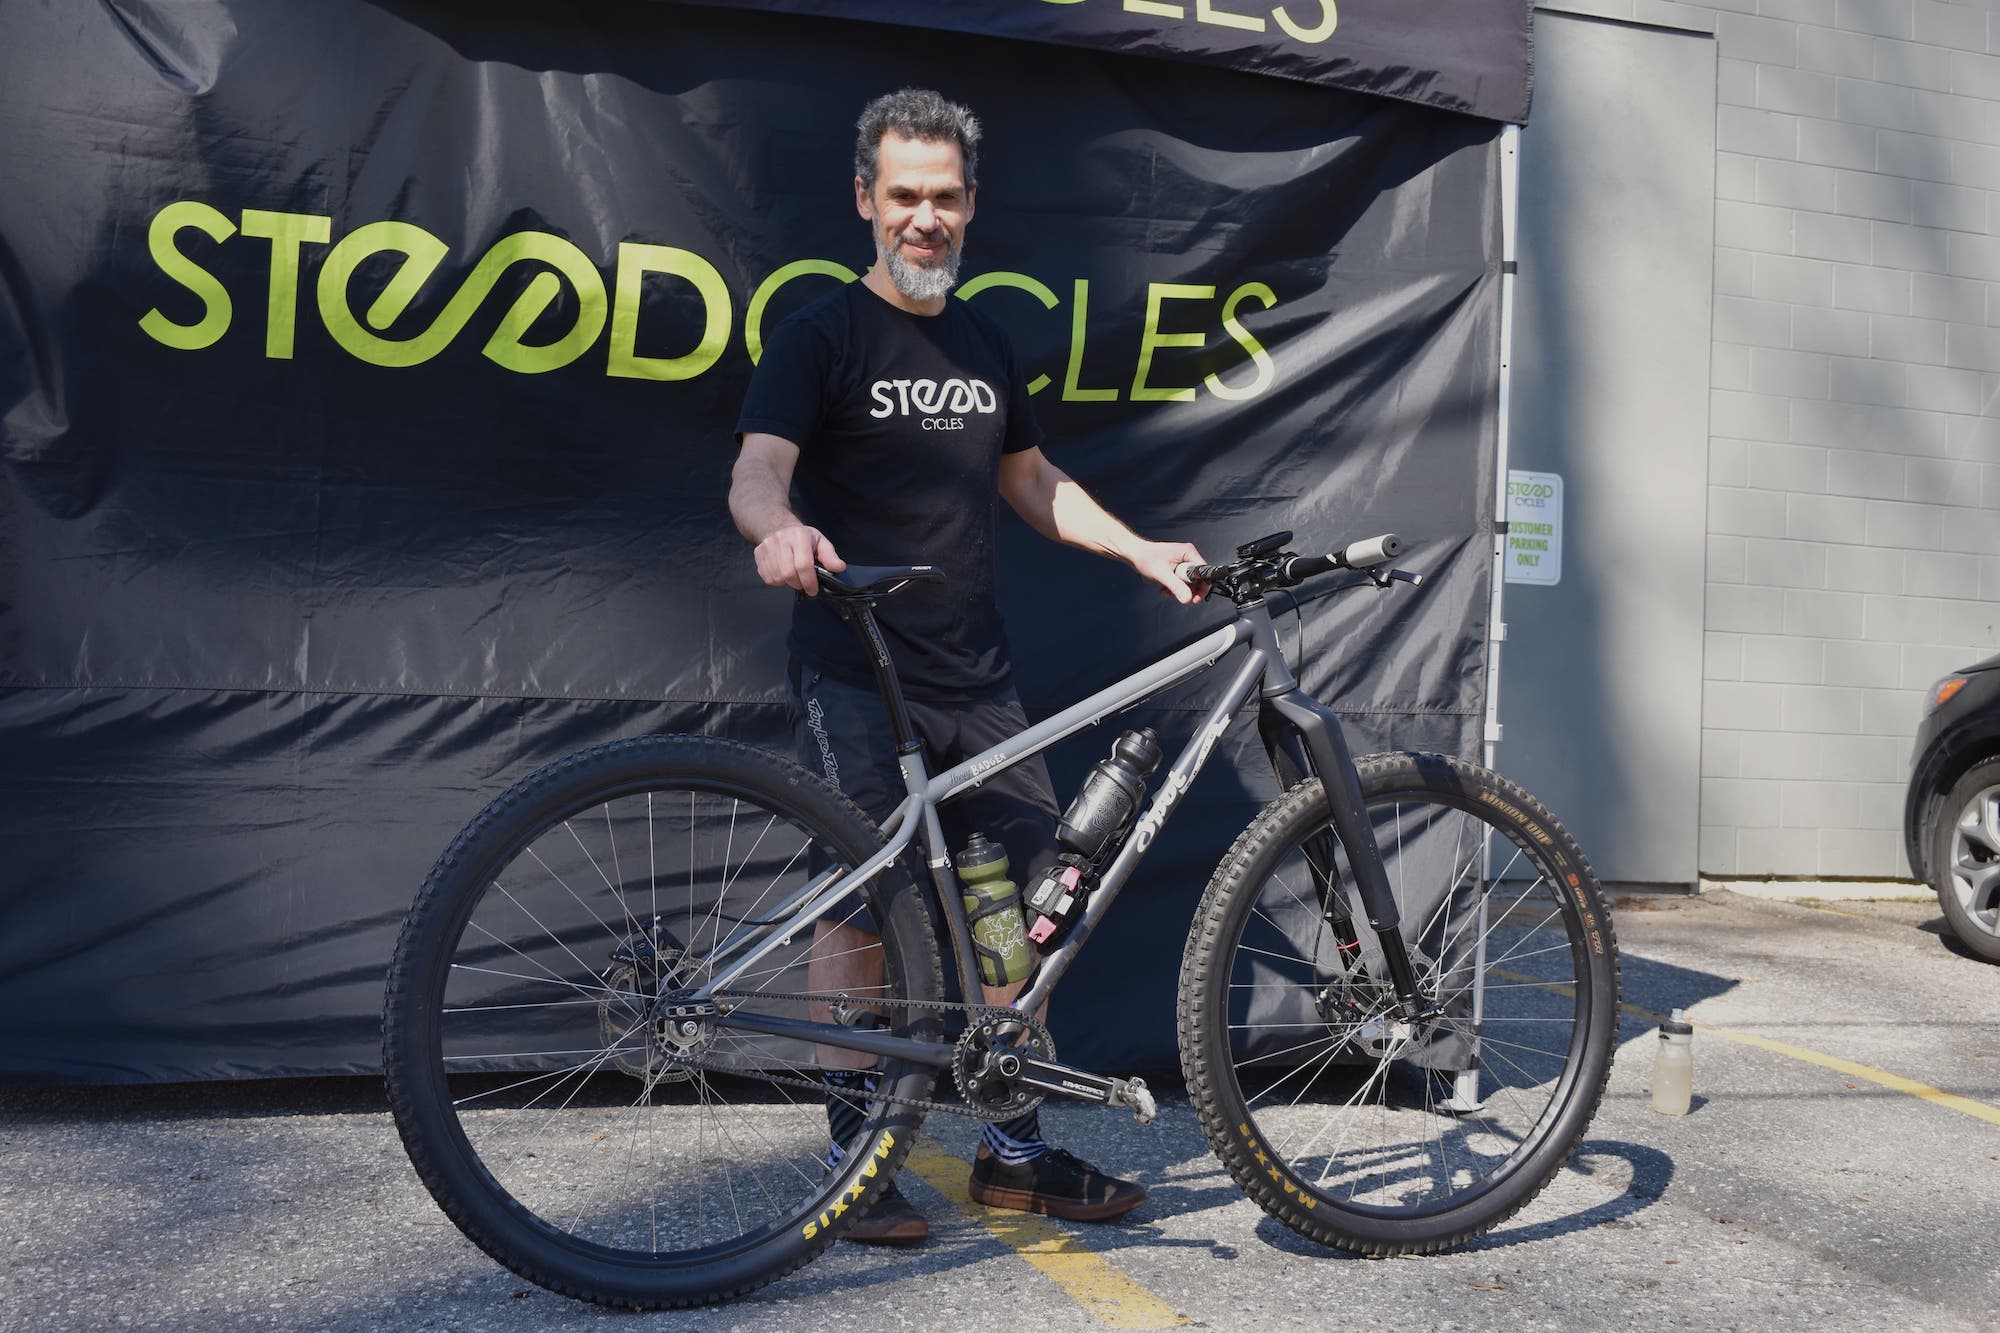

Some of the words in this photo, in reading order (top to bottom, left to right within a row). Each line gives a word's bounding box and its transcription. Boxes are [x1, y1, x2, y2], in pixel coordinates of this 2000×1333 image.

[921, 417, 965, 431] CYCLES
[1509, 537, 1549, 551] PARKING
[1517, 553, 1541, 567] ONLY
[970, 752, 1007, 776] BADGER
[1239, 1122, 1318, 1210] MAXXIS
[802, 1130, 895, 1241] MAXXIS
